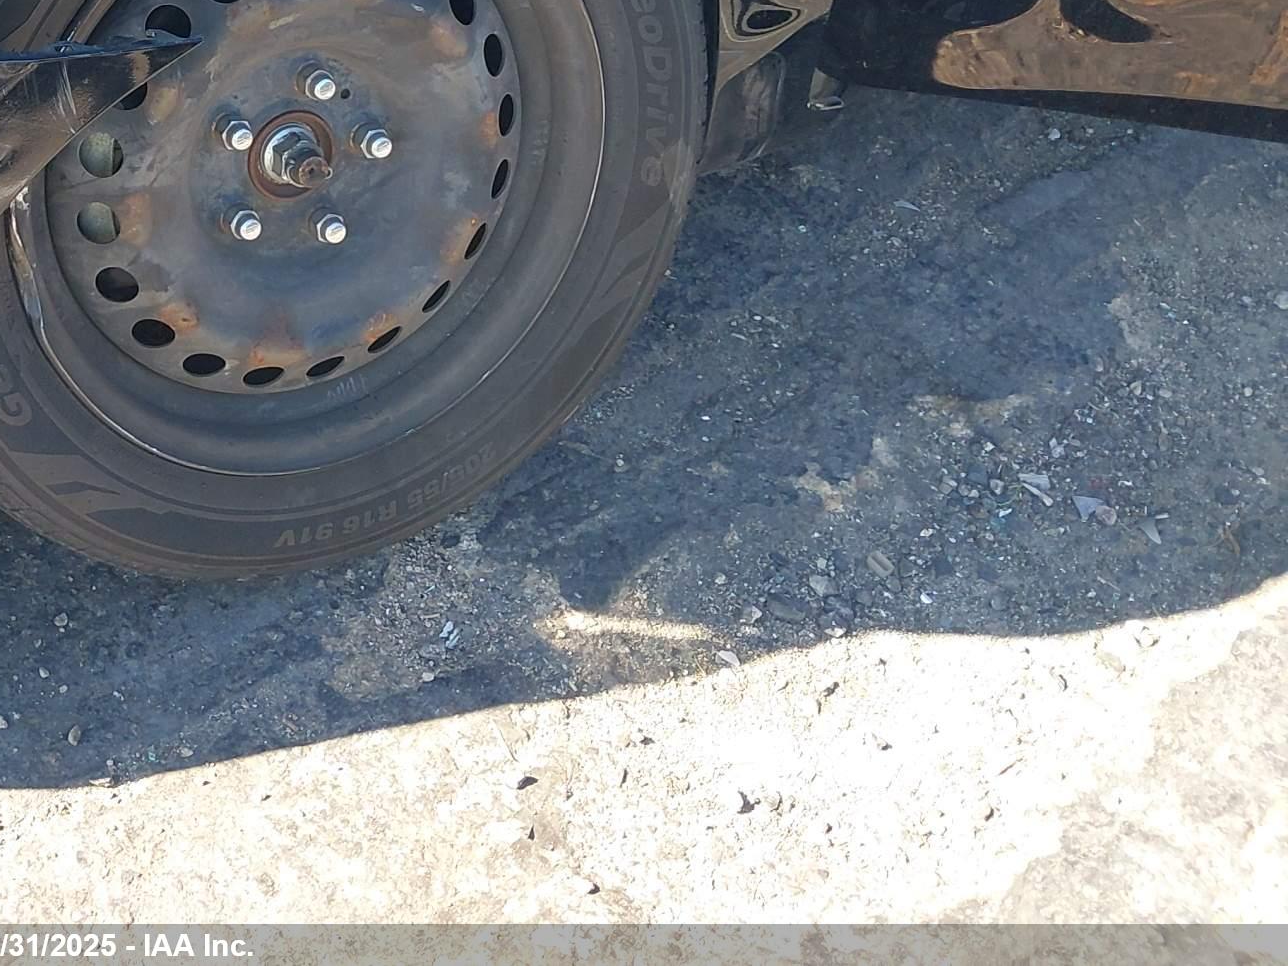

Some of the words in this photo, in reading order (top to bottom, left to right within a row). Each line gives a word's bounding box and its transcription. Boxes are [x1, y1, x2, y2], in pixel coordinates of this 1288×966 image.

[407, 441, 496, 510] 205/55
[342, 500, 398, 534] R16
[272, 522, 334, 549] 91V
